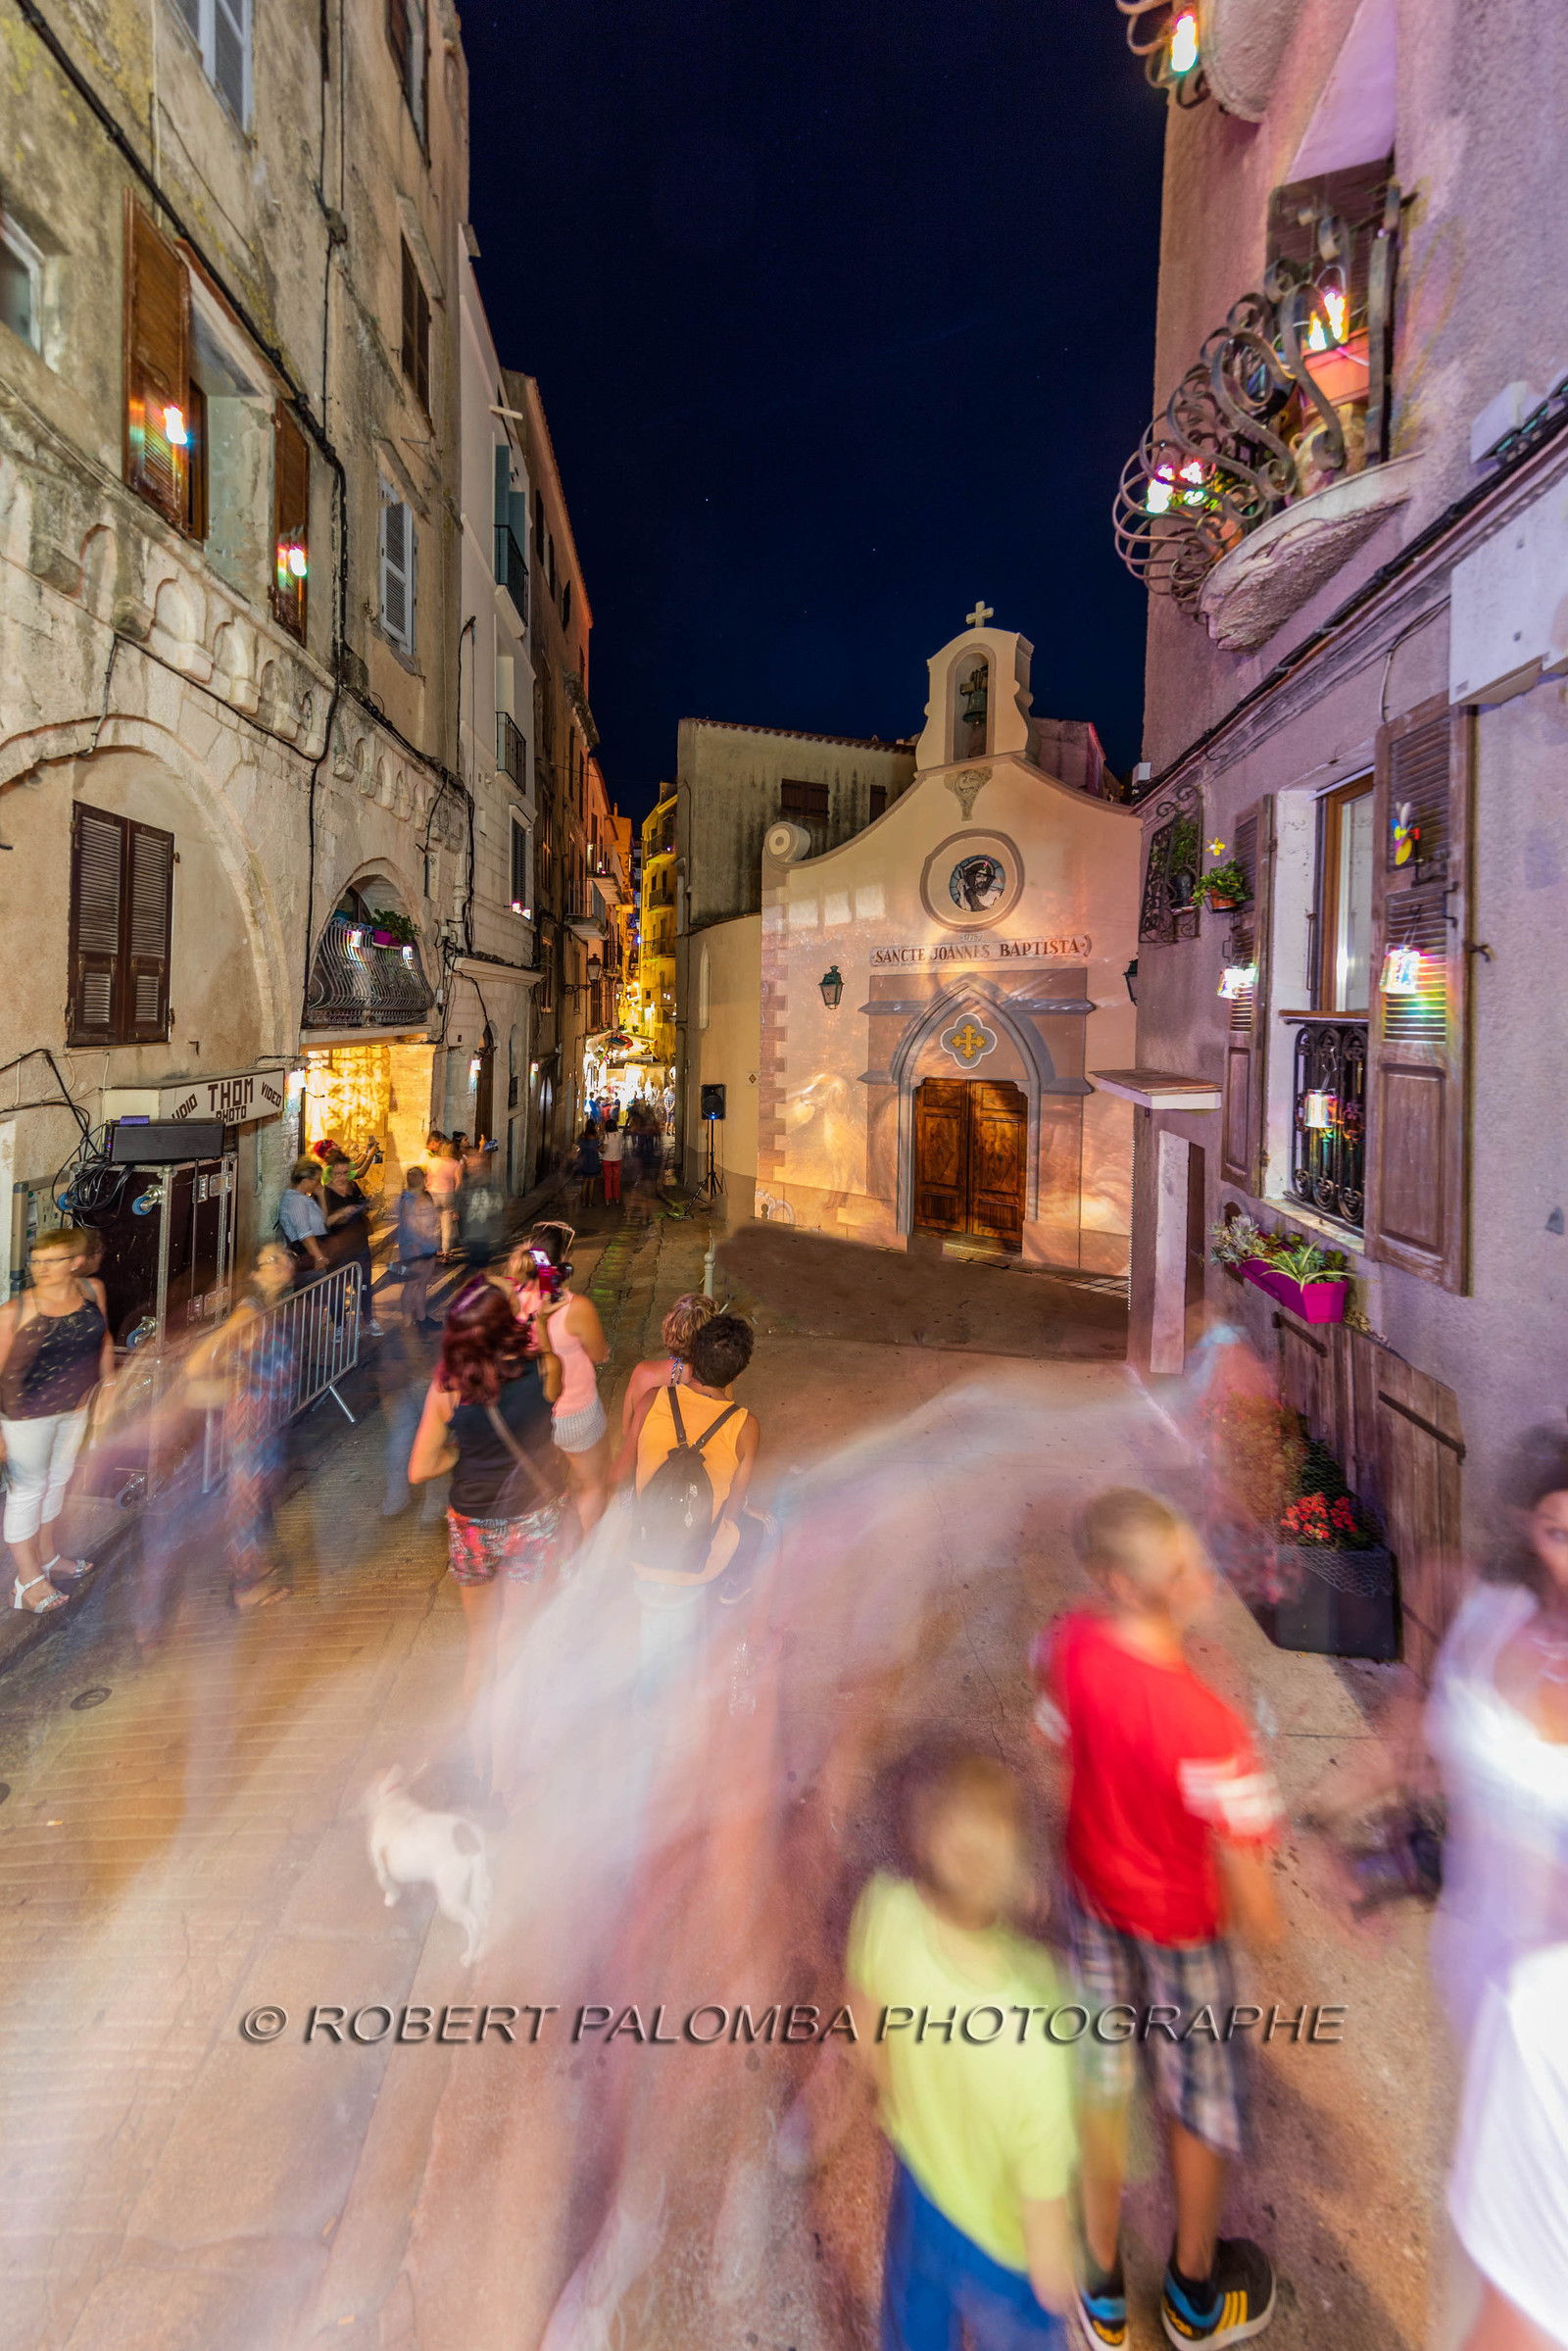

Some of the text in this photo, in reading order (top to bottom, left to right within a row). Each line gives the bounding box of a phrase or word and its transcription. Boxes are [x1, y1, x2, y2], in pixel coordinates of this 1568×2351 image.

[875, 938, 1080, 963] SANCTE JOANNES BAPTISTA
[208, 1077, 254, 1112] THOM
[261, 1081, 282, 1108] VIDEO
[216, 1104, 247, 1123] PHOTO
